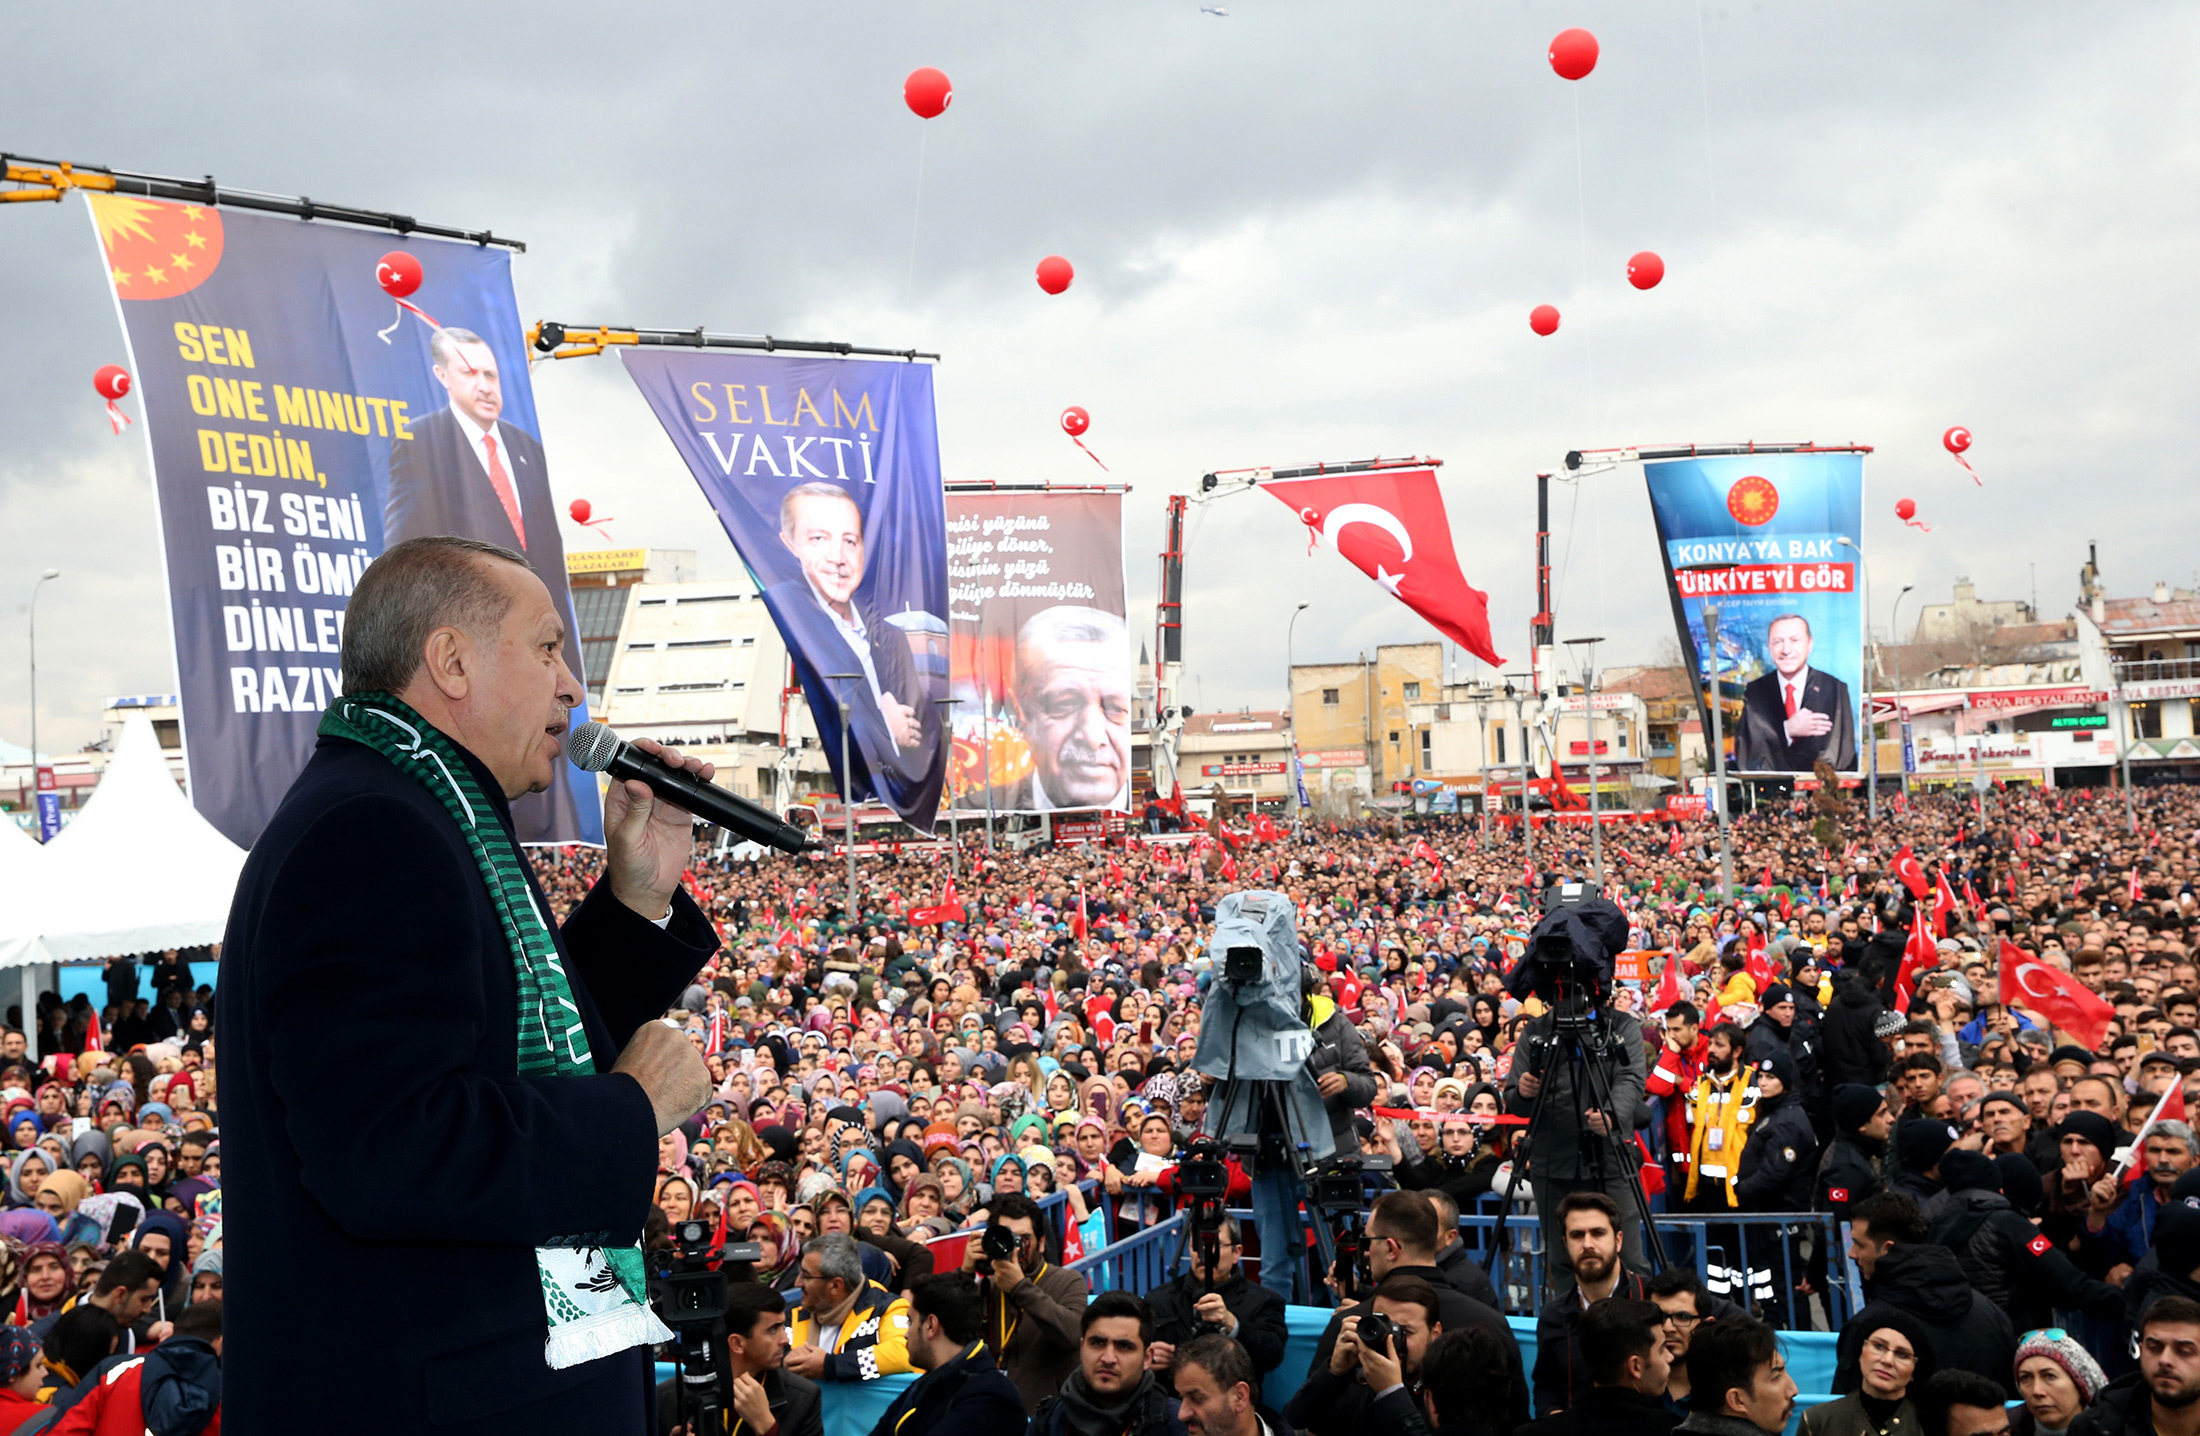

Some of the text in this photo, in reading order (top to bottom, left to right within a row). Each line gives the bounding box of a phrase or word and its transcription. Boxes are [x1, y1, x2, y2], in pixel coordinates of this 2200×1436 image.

[174, 322, 255, 368] SEN
[187, 374, 414, 440] ONE MINUTE
[691, 381, 881, 432] SELAM
[197, 430, 327, 489] DEDİN,
[700, 432, 877, 484] VAKTİ
[207, 480, 366, 542] BİZ SENİ
[982, 515, 1051, 536] yüzünü
[215, 538, 286, 592] BİR
[1004, 559, 1051, 580] yüzü
[1679, 539, 1834, 563] KONYA'YA BAK
[999, 580, 1095, 601] dönmüştür
[1800, 564, 1846, 589] GÖR
[223, 598, 346, 653] DİNLE
[1976, 692, 2105, 708] DEVA RESTAURANT
